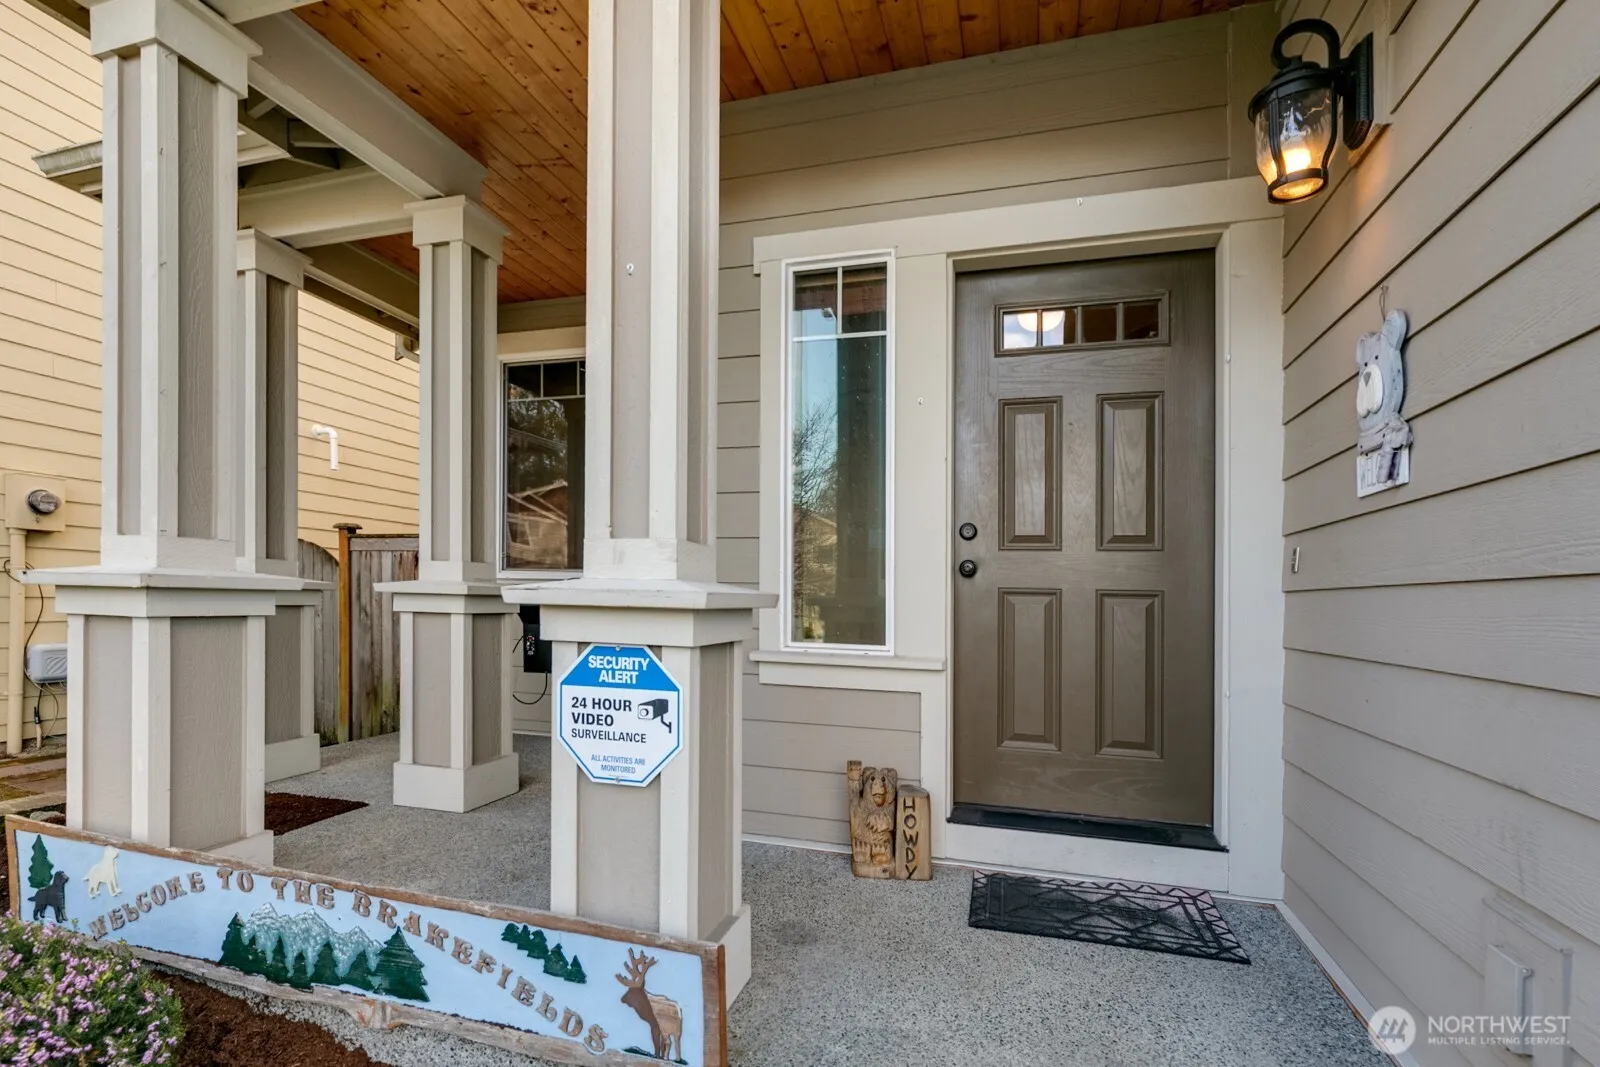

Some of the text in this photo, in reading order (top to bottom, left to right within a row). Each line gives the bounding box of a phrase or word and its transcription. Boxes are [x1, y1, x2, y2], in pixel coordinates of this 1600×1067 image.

[588, 655, 649, 670] SECURITY
[599, 671, 639, 684] ALERT
[571, 696, 632, 712] 24 HOUR
[571, 711, 614, 727] VIDEO
[571, 728, 646, 743] SURVEILLANCE
[591, 754, 646, 766] ALL ACTIVITIES ARE
[600, 764, 636, 774] MONITORED
[903, 797, 918, 879] HOWDY
[89, 867, 608, 1051] WELCOME TO THE BRAKEFIELDS
